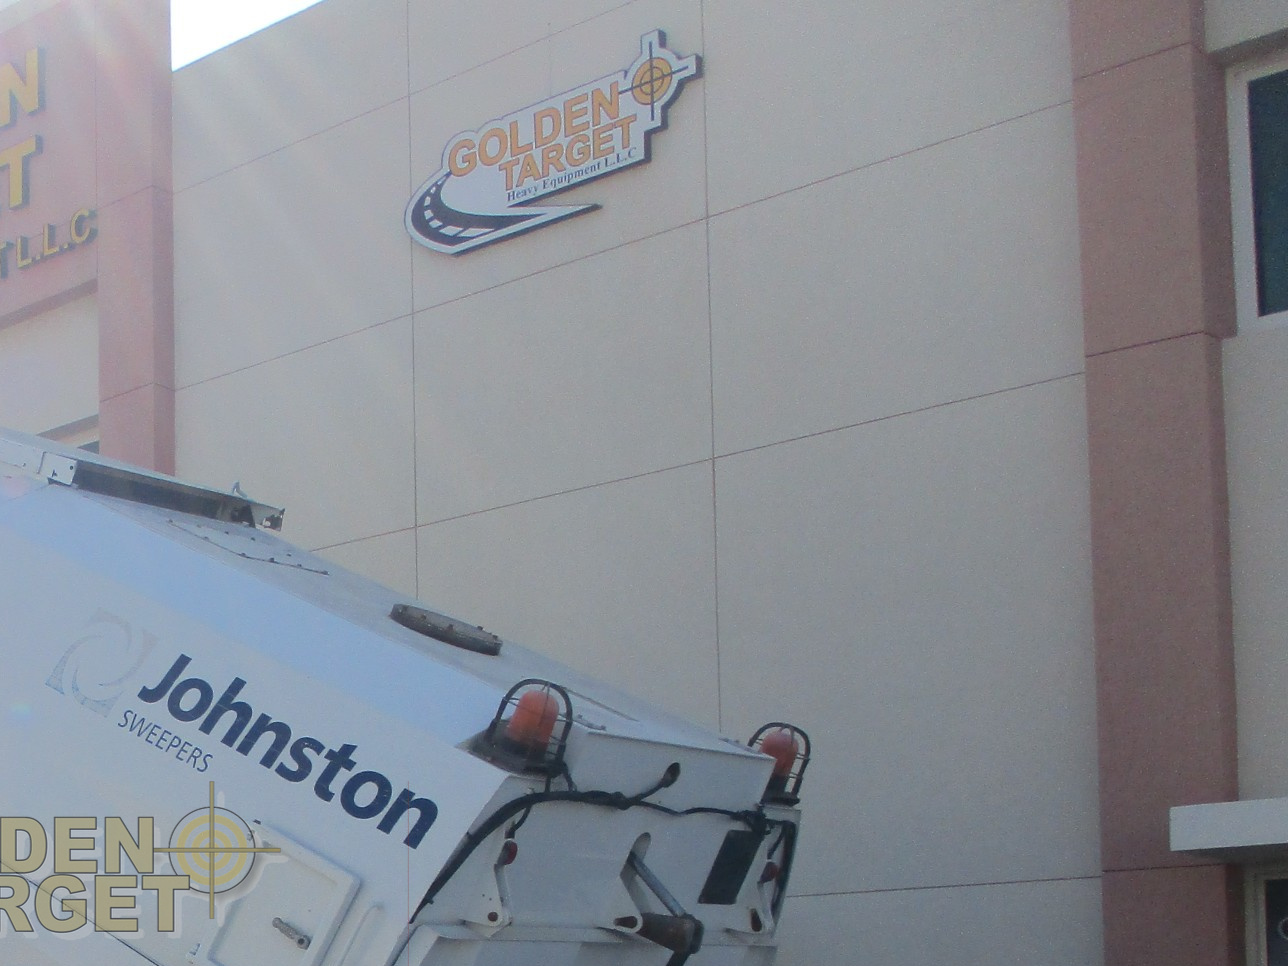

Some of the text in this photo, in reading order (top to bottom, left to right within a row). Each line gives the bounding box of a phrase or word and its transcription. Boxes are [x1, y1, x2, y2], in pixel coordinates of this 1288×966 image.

[448, 80, 619, 177] GOLDEN
[499, 114, 637, 192] TARGET
[507, 147, 637, 202] Heavy Equipment L.L.C
[16, 208, 94, 269] L.L.C
[117, 709, 214, 773] SWEEPERS
[138, 654, 438, 850] Johnston
